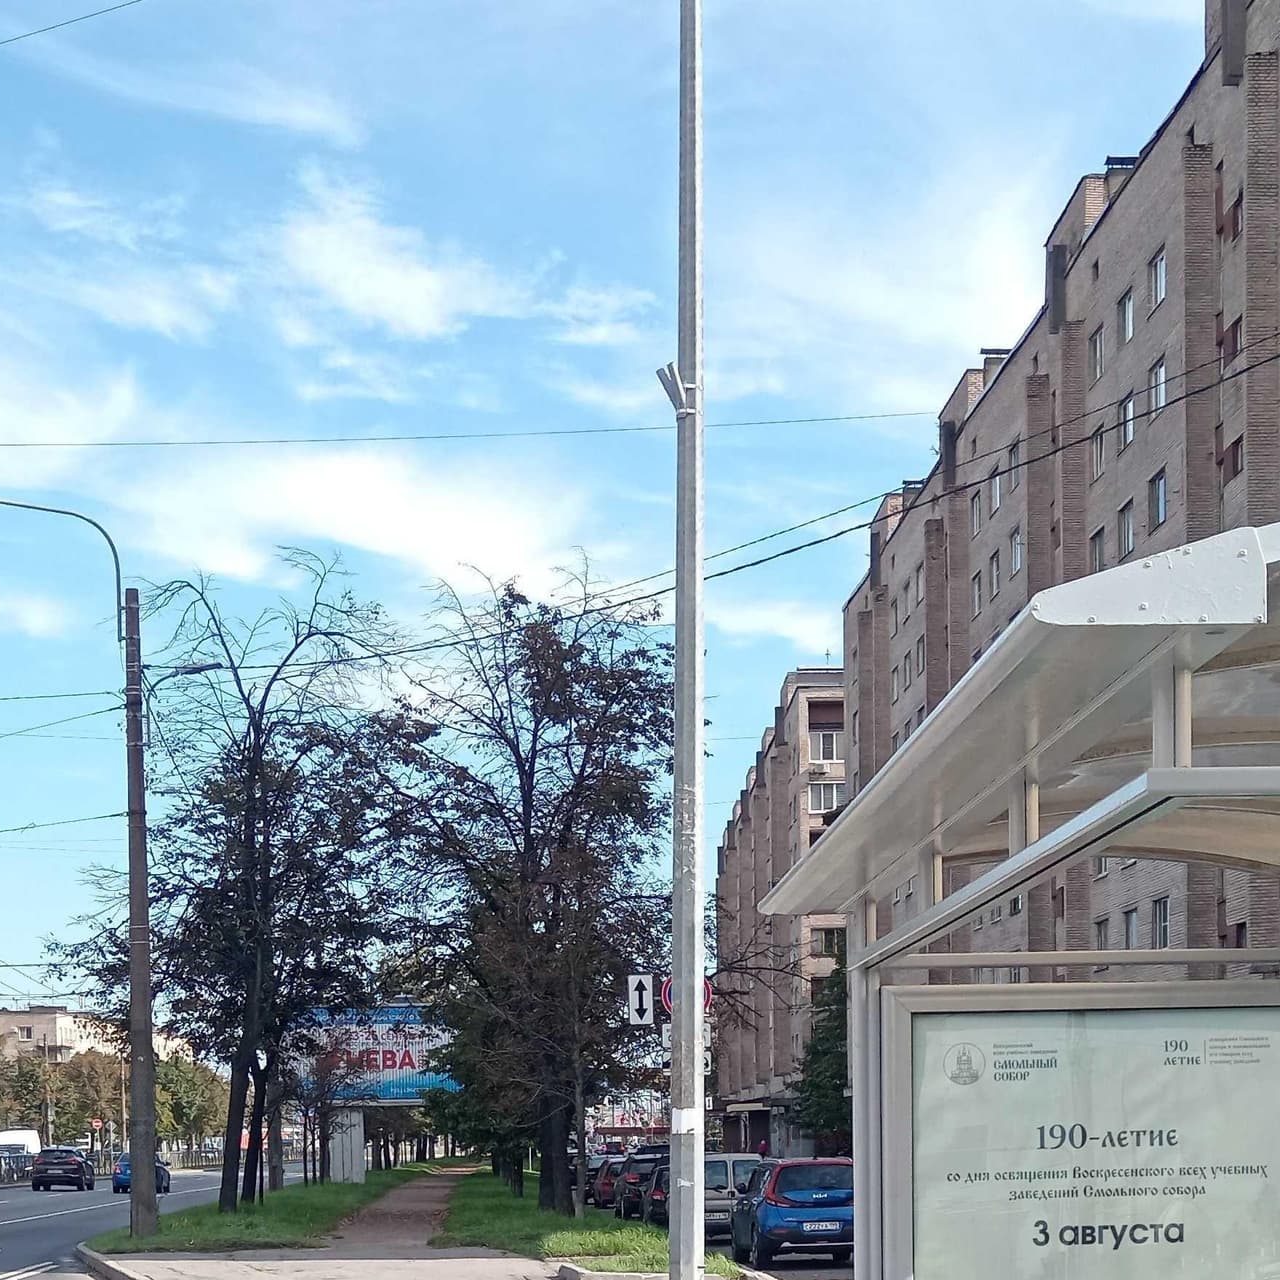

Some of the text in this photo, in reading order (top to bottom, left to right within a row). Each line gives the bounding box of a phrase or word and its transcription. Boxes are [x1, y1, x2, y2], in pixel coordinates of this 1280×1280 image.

[1163, 1039, 1189, 1053] 190
[993, 1057, 1058, 1070] СМОЛЬНЫЙ
[993, 1071, 1030, 1082] СОБОР
[1036, 1123, 1179, 1150] 190-летие
[947, 1164, 1269, 1184] со дня освящения Воскресенского всех учебных
[1008, 1184, 1206, 1201] заведений Смольного собора
[1032, 1219, 1185, 1251] 3 августа
